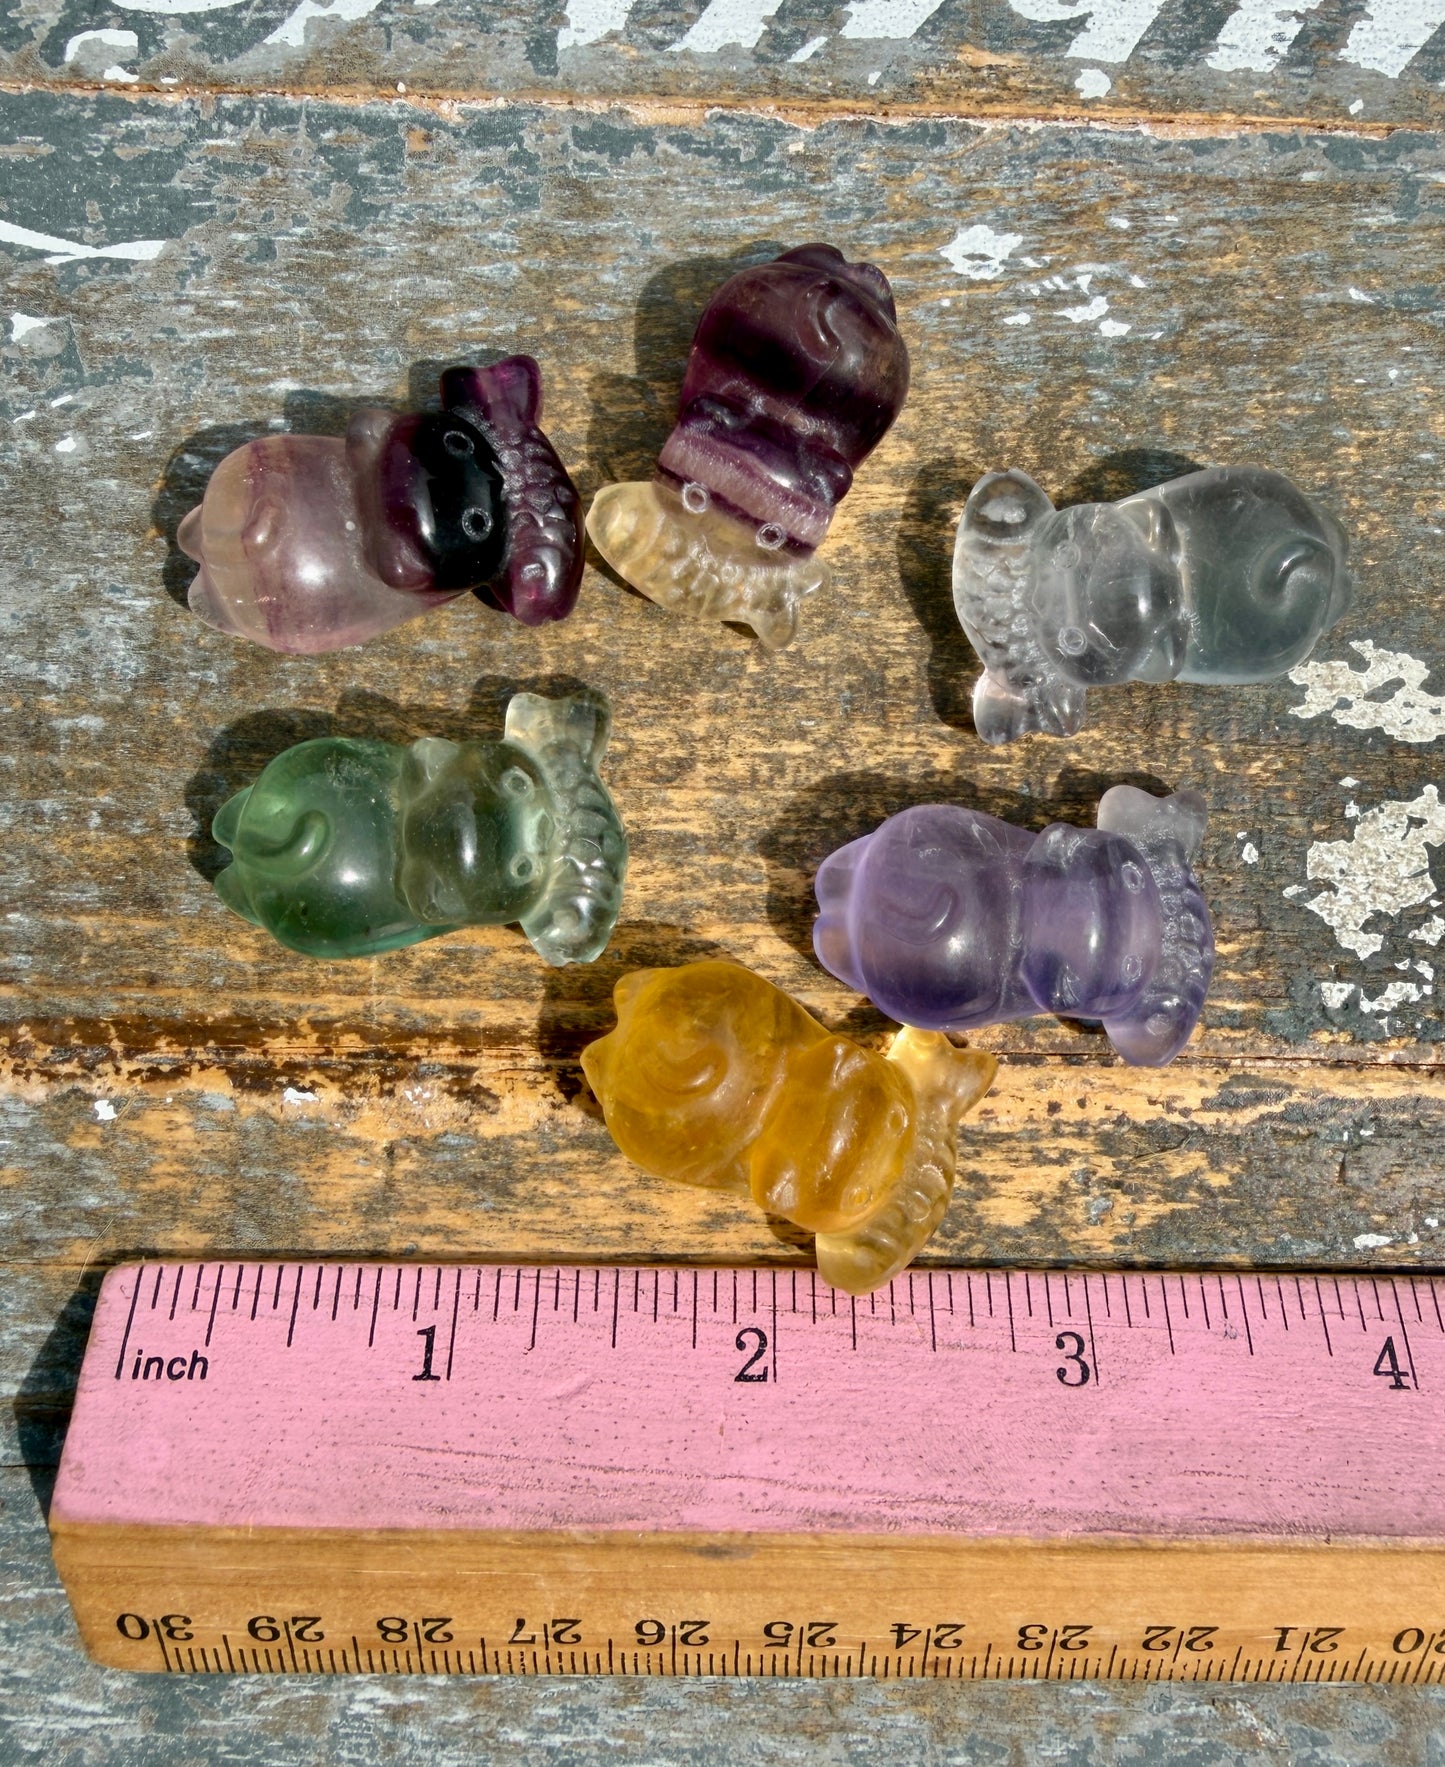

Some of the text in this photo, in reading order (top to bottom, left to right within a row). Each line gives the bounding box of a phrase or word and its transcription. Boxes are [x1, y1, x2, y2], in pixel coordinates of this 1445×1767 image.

[132, 1325, 1410, 1389] inch 1 2 3 4
[116, 1613, 1445, 1653] 0 21 22 23 24 25 26 27 28 29 30
